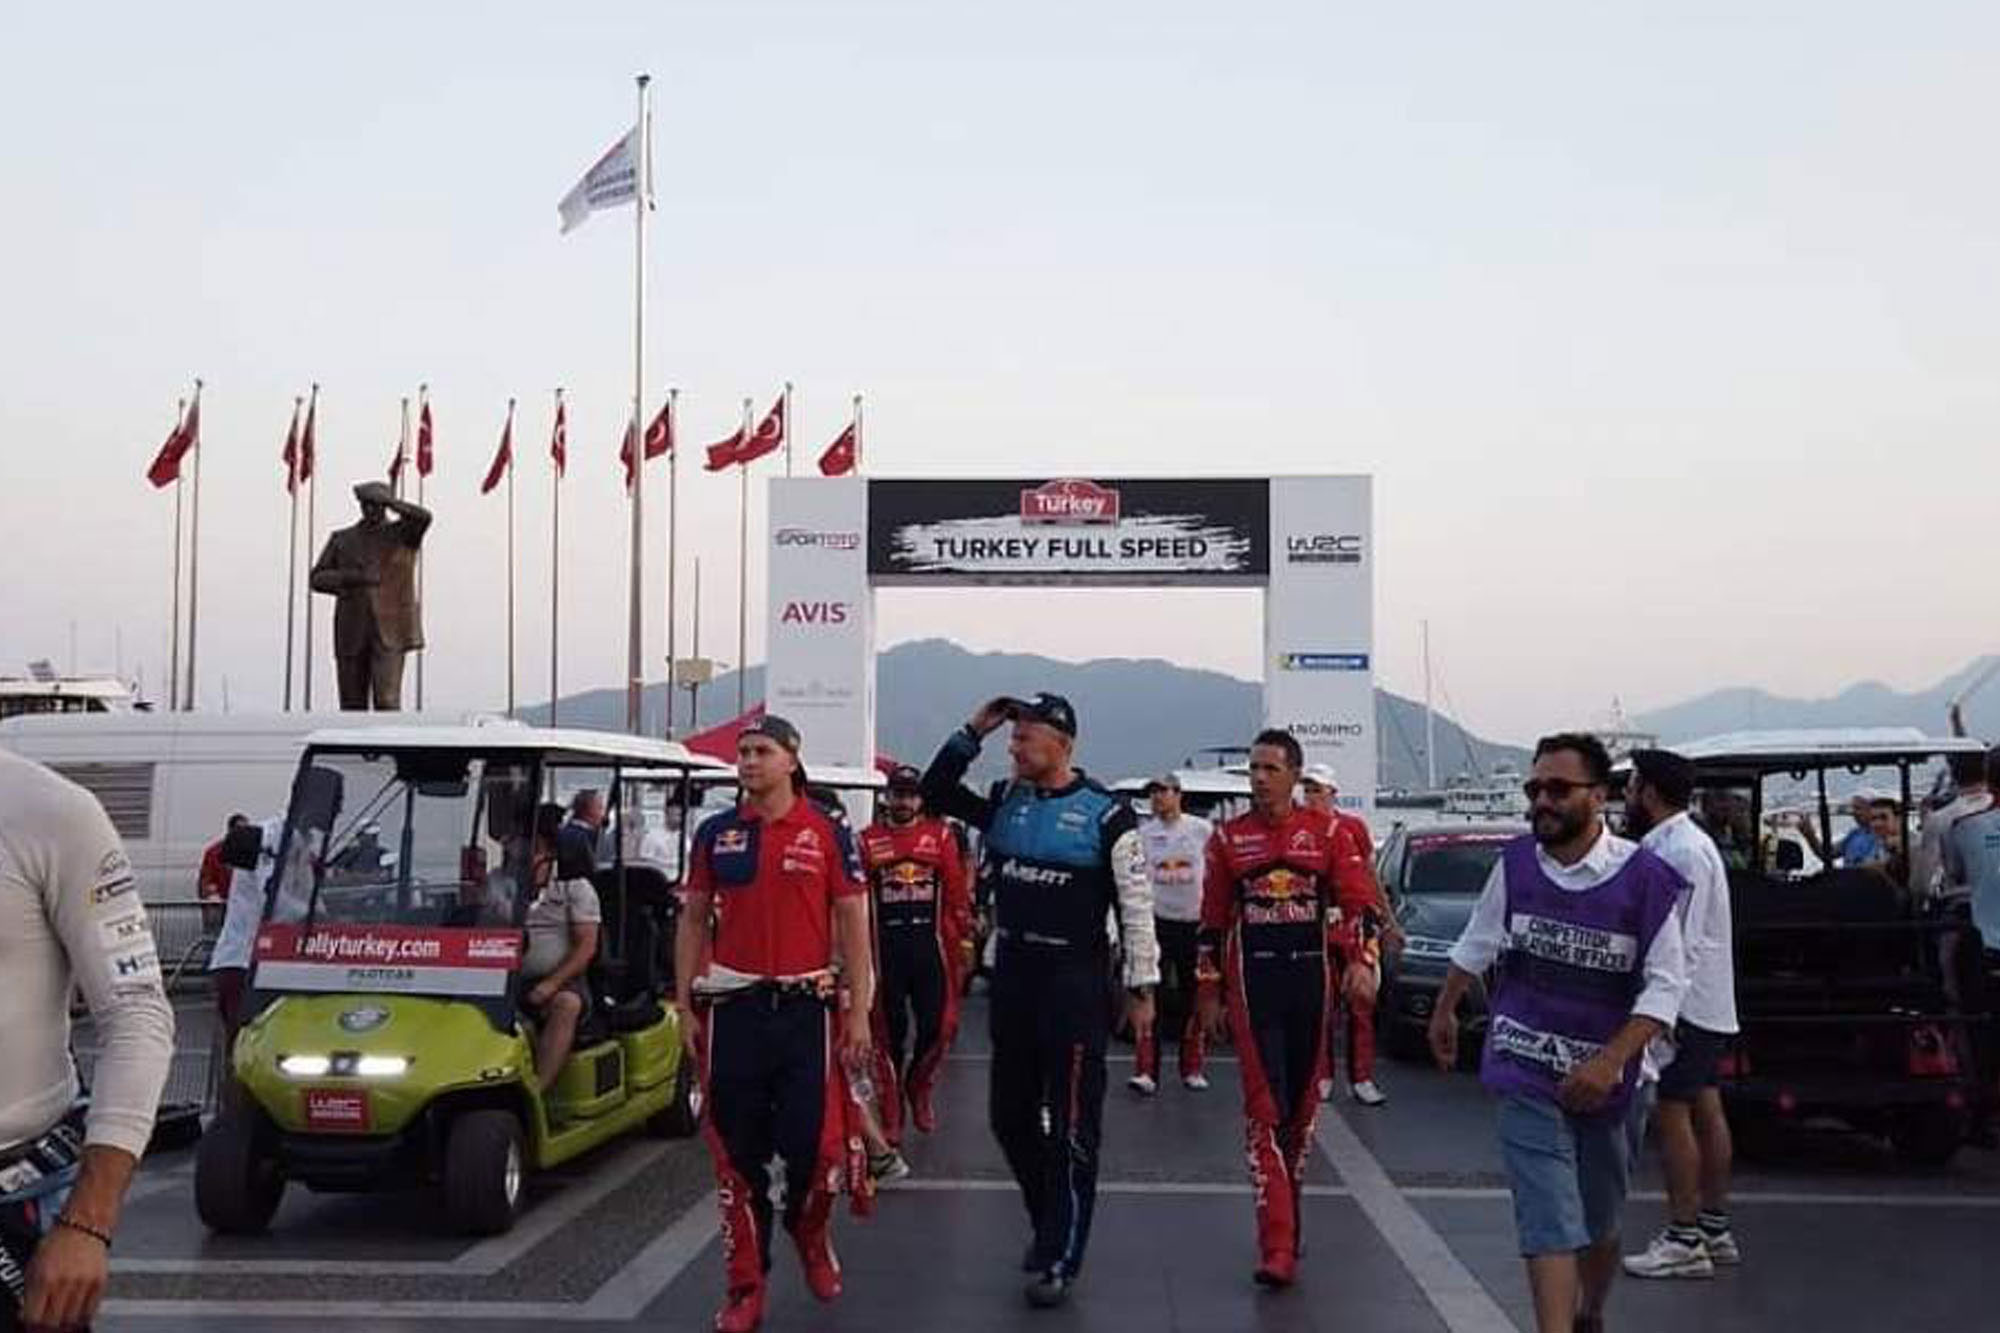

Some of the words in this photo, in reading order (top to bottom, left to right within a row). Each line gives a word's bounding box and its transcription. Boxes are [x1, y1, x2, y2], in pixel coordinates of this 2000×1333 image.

[1034, 494, 1106, 515] Turkey
[933, 537, 1038, 559] TURKEY
[1048, 537, 1113, 559] FULL
[1120, 537, 1208, 559] SPEED
[781, 601, 847, 623] AVIS
